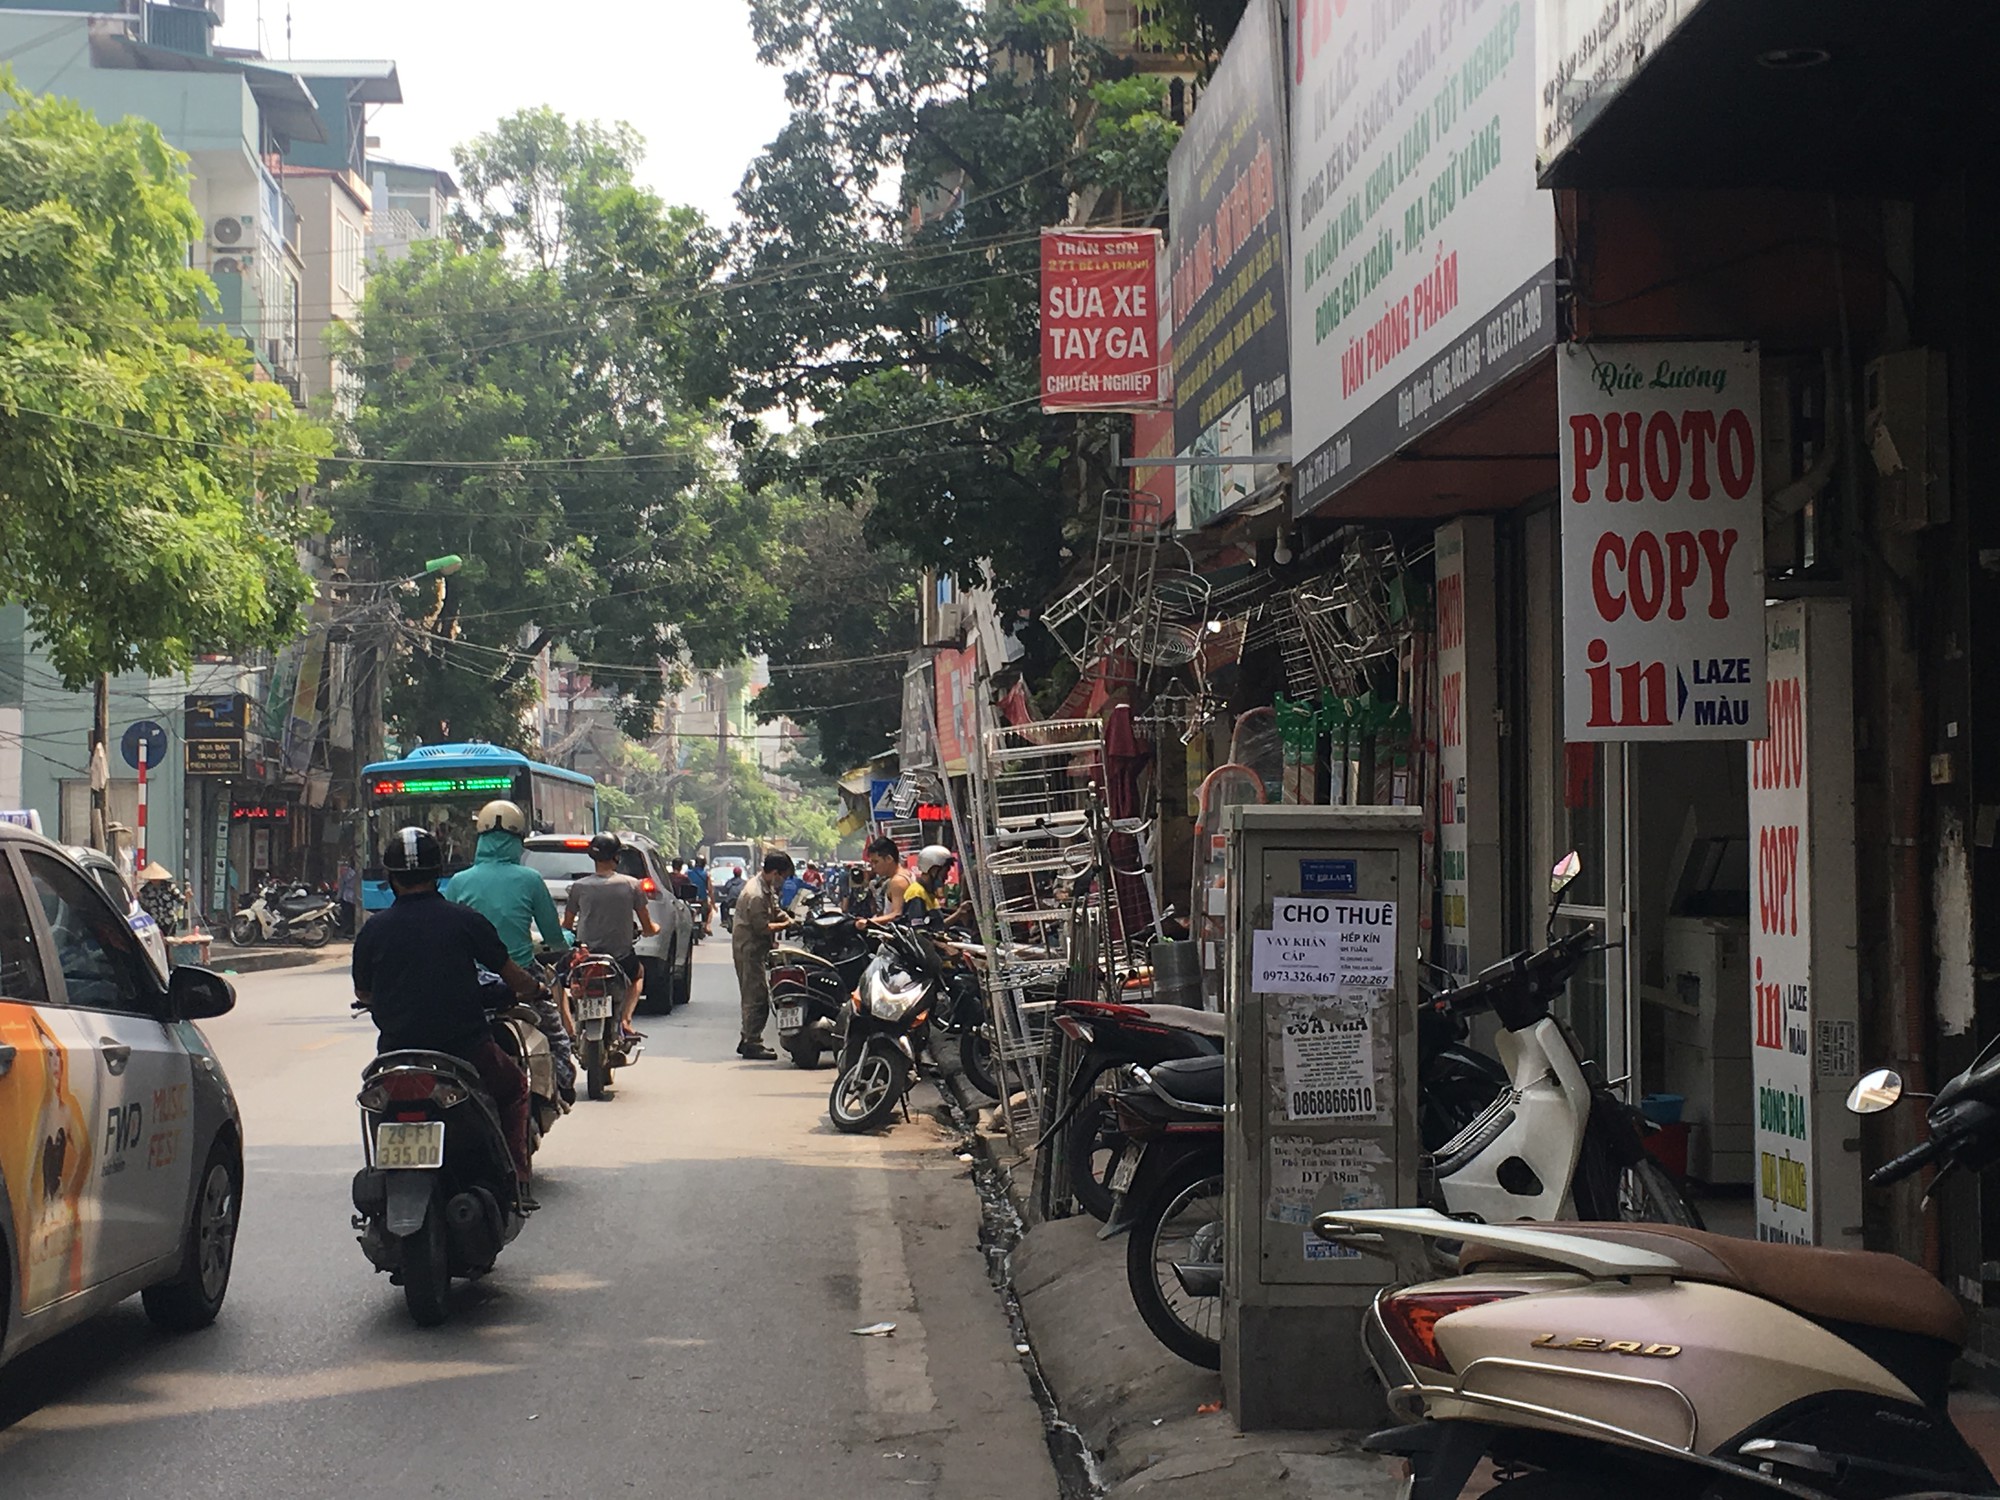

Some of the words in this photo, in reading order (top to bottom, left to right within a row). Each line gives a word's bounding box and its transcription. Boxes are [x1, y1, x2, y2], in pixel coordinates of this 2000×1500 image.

[1404, 196, 1425, 256] MẠ
[1460, 114, 1501, 199] VÀNG
[1049, 277, 1105, 319] SỬA
[1112, 285, 1147, 318] XE
[1341, 335, 1364, 401] VĂN
[1367, 295, 1410, 380] PHÒNG
[1414, 239, 1459, 341] PHẨM
[1049, 328, 1102, 360] TAY
[1105, 327, 1149, 359] GA
[1047, 371, 1098, 393] CHUYÊN
[1103, 373, 1151, 395] NGHIỆP
[1648, 359, 1727, 394] Lương
[1569, 409, 1755, 504] PHOTO
[1591, 528, 1738, 623] COPY
[1585, 639, 1673, 728] in
[1693, 658, 1751, 684] LAZE
[1694, 697, 1749, 726] MÀU
[1759, 825, 1799, 938] COPY
[1283, 904, 1330, 924] CHO
[1336, 903, 1394, 926] THUÊ
[1266, 936, 1290, 948] VAY
[1363, 932, 1381, 944] KÍN
[1263, 970, 1336, 983] 0973.326.467
[1340, 974, 1389, 986] 7.002.267
[1755, 956, 1783, 1050] in
[1788, 983, 1808, 1012] LAZE
[1293, 1087, 1372, 1116] 0868866610
[104, 1102, 142, 1156] FWD
[1530, 1333, 1682, 1358] LEAD
